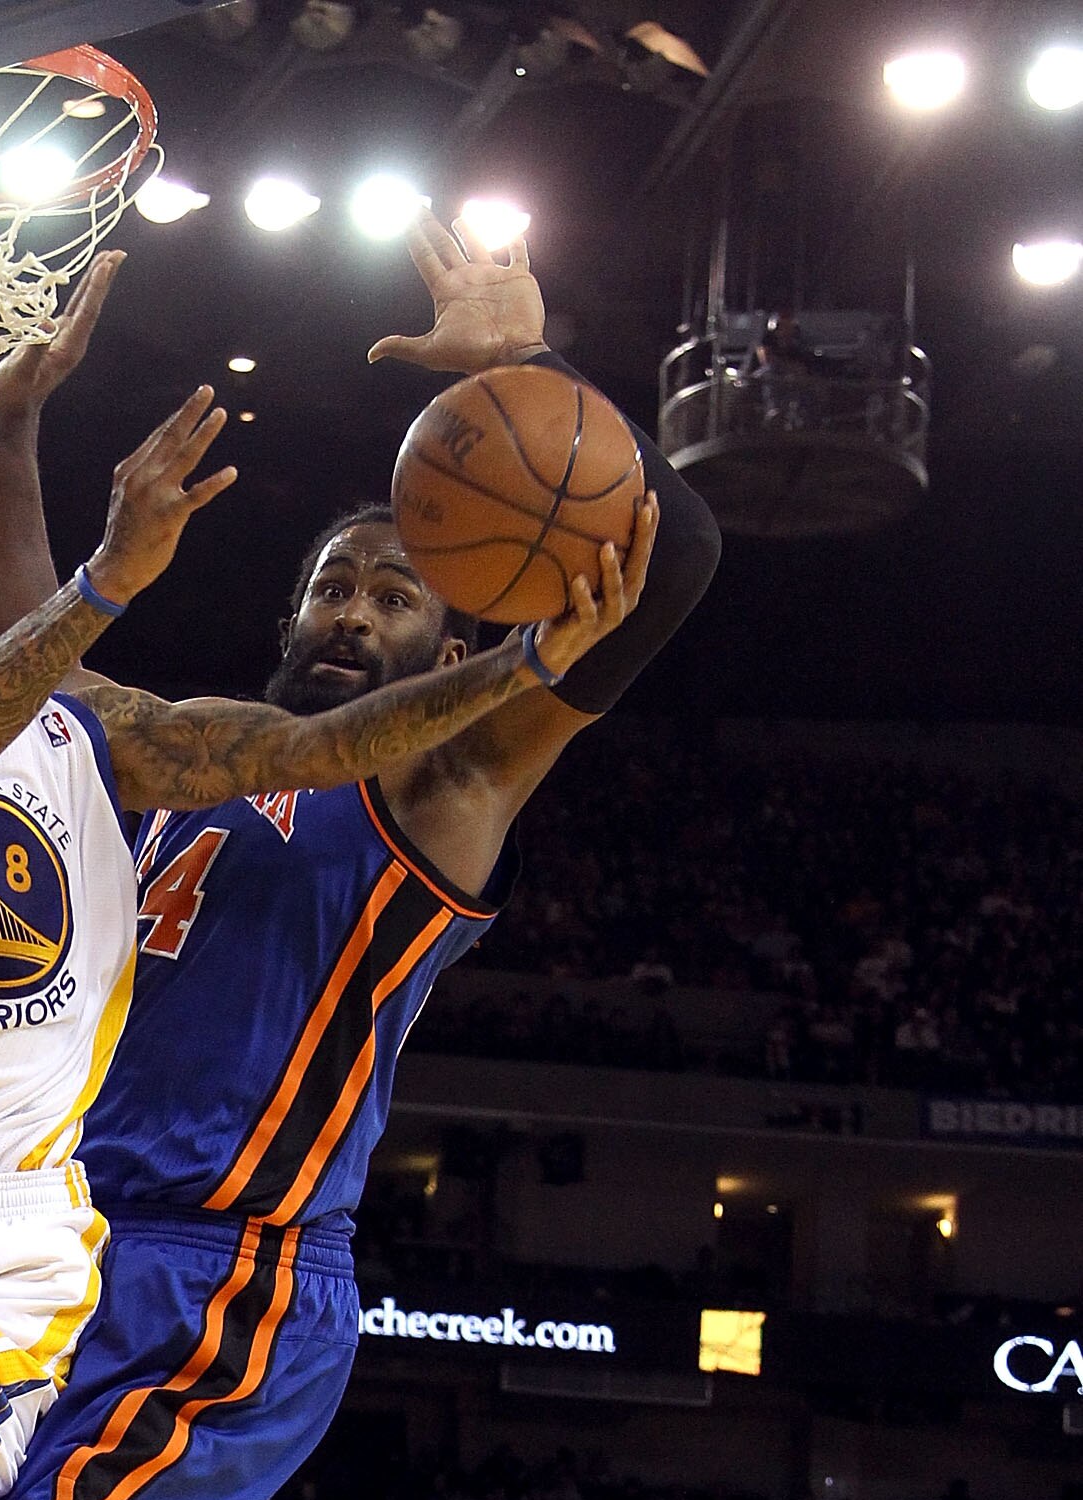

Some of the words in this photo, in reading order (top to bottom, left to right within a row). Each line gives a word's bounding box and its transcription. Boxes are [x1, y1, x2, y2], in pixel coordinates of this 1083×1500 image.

[11, 783, 72, 850] STATE
[5, 843, 32, 894] 8
[136, 825, 231, 961] 4
[931, 1100, 1083, 1137] BIEDRI
[358, 1296, 617, 1353] checreek.com
